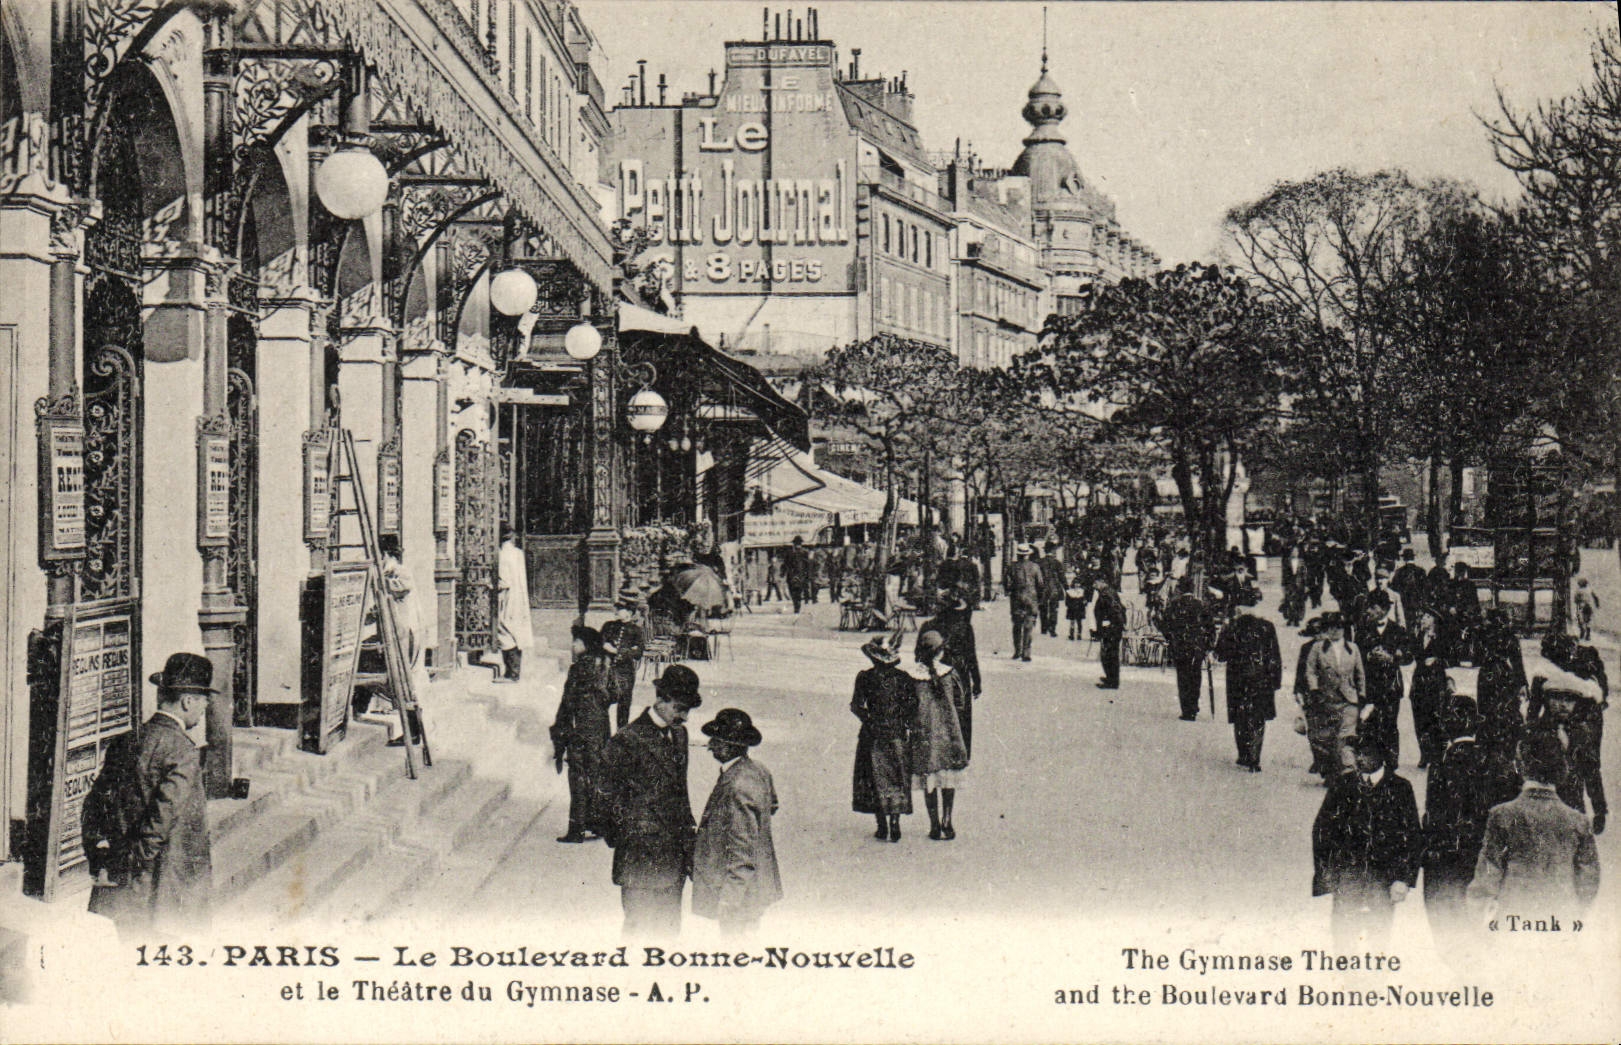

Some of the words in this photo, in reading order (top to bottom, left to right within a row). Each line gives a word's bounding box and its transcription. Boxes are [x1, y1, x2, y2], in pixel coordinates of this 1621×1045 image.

[757, 48, 825, 60] DUFAYEL
[760, 75, 801, 90] LE
[700, 117, 769, 152] Le
[619, 159, 703, 246] Petit
[712, 158, 849, 246] Journal
[683, 258, 699, 281] &
[706, 252, 732, 283] 8
[738, 259, 823, 282] PAGES
